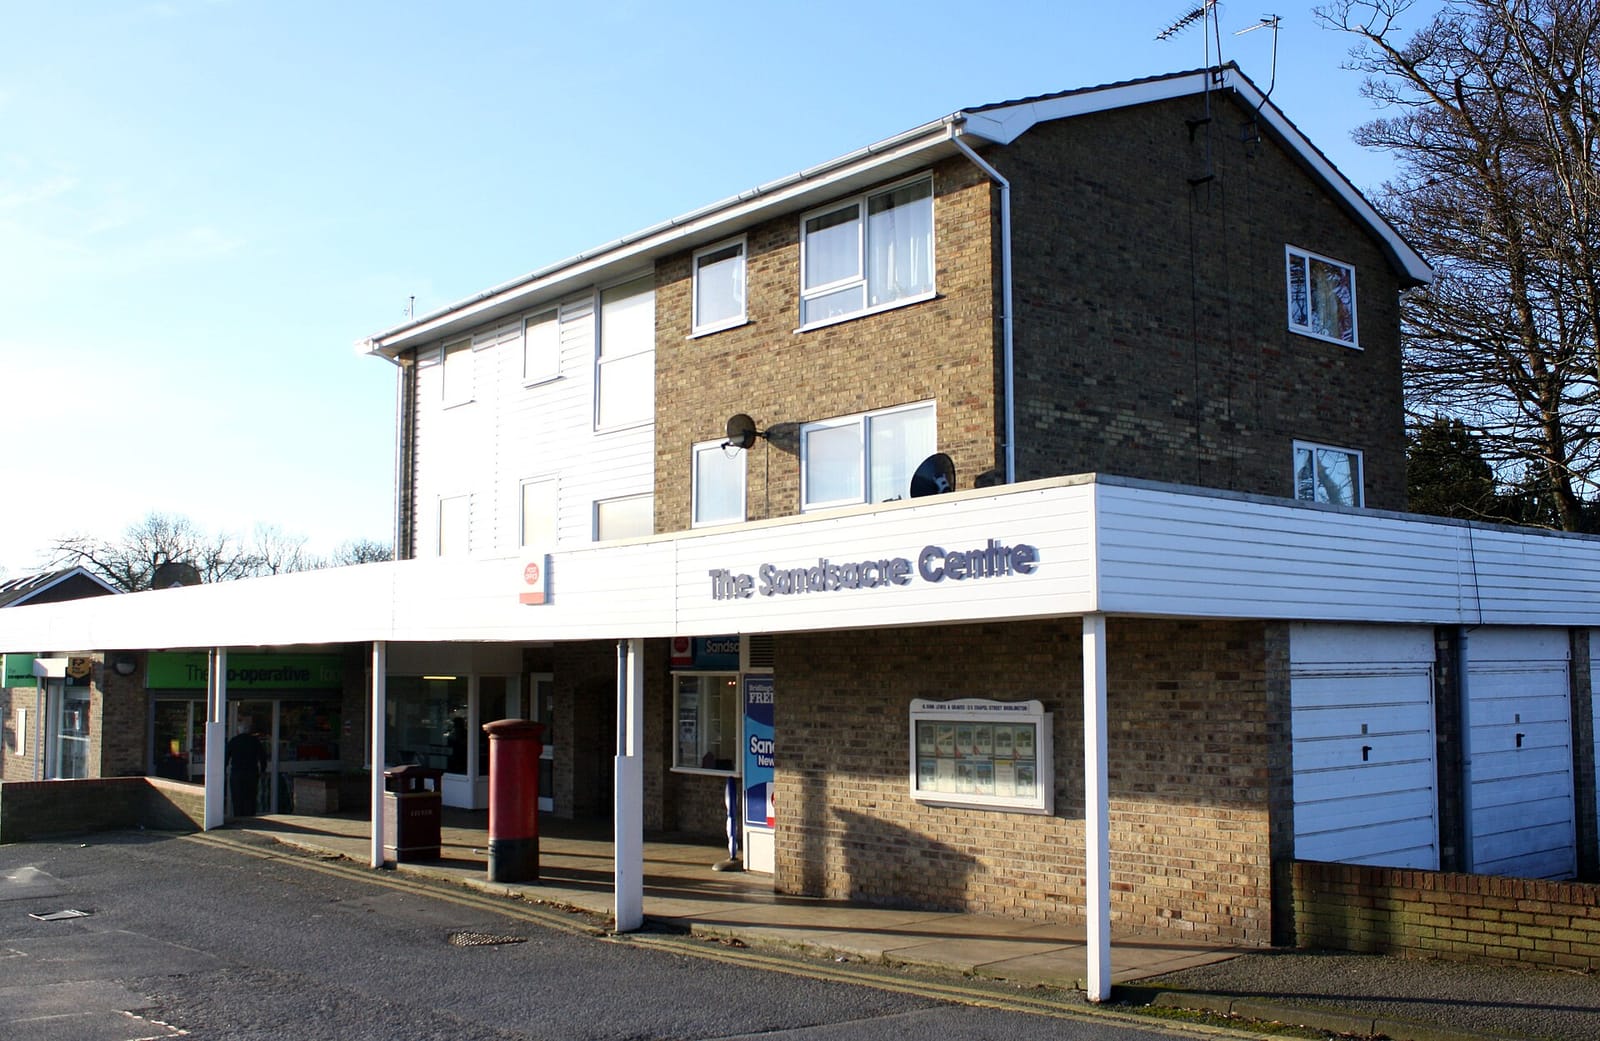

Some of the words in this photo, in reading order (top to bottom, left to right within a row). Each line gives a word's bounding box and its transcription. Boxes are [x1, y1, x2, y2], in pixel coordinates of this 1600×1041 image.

[709, 568, 753, 600] The
[759, 558, 913, 596] Sandsacre
[918, 538, 1040, 583] Centre
[185, 663, 208, 681] The
[226, 665, 310, 684] o-operative
